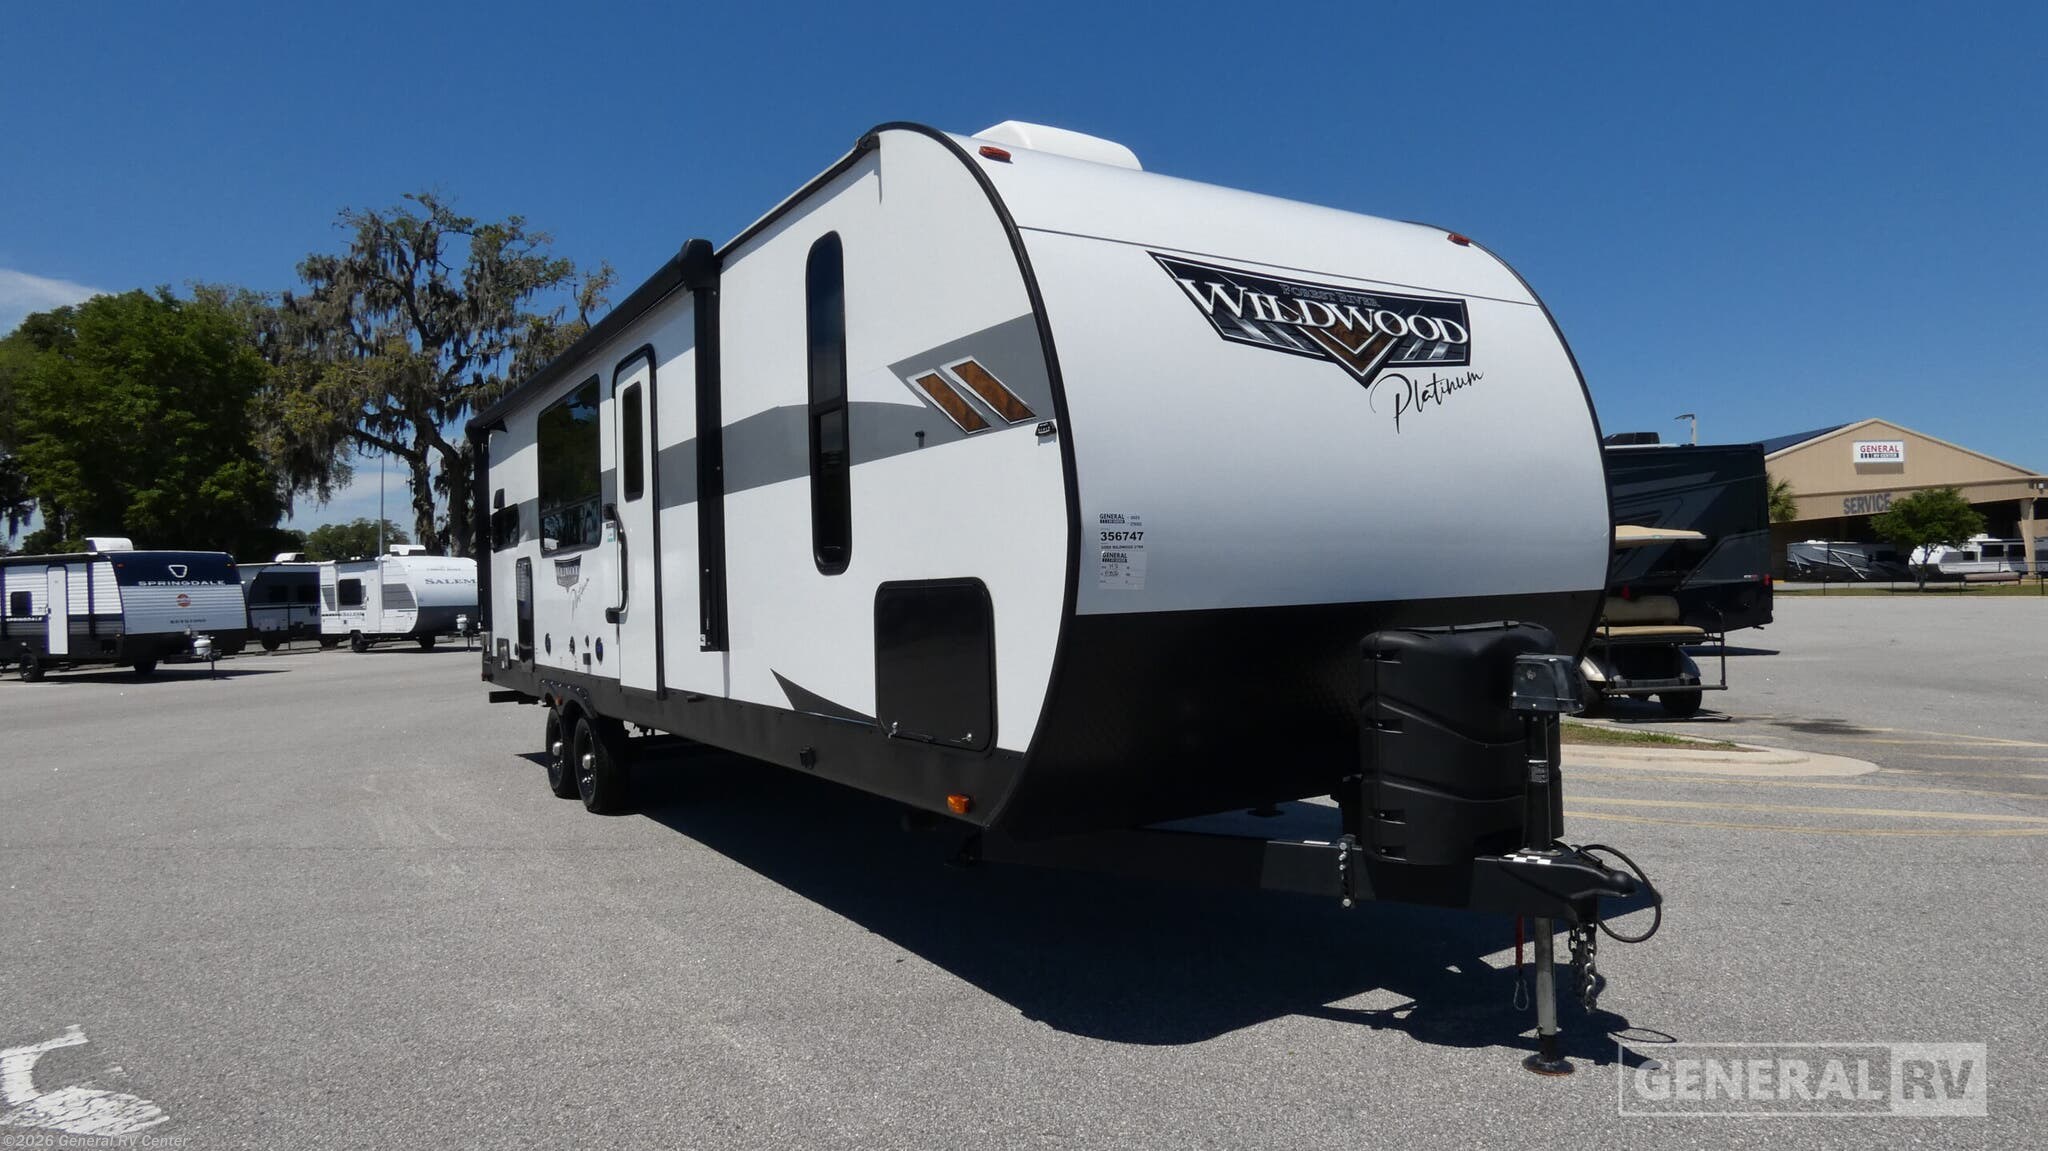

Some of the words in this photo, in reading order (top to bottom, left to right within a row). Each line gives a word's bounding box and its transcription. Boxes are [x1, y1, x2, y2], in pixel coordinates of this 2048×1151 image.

[1279, 283, 1335, 301] FOREST
[1175, 277, 1469, 344] WILDWOOD
[1369, 371, 1484, 434] Platinum
[1860, 445, 1899, 453] GENERAL
[1843, 492, 1891, 514] SERVICE
[1100, 531, 1144, 541] 356747
